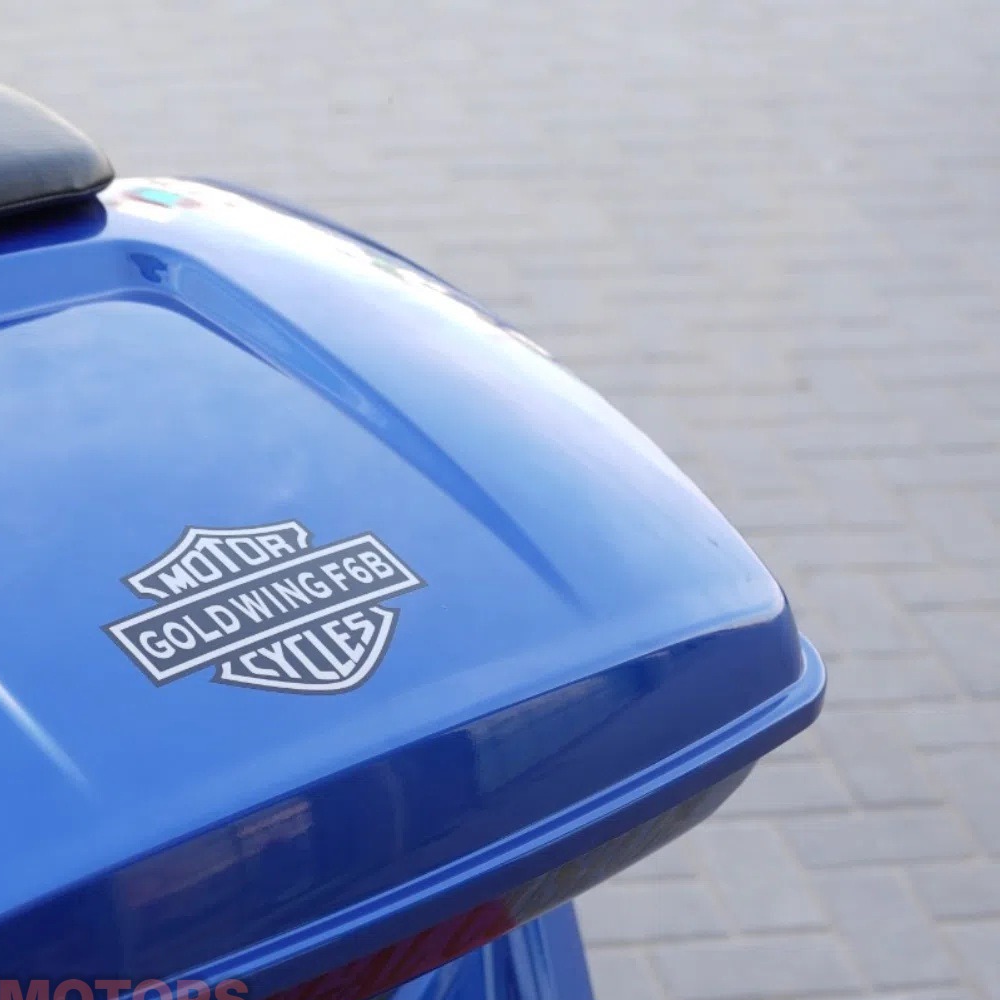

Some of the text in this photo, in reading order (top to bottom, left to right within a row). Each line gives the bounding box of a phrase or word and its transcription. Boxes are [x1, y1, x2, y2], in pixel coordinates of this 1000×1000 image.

[157, 533, 294, 595] MOTOR
[320, 551, 394, 592] F6B
[239, 611, 376, 680] CYCLES
